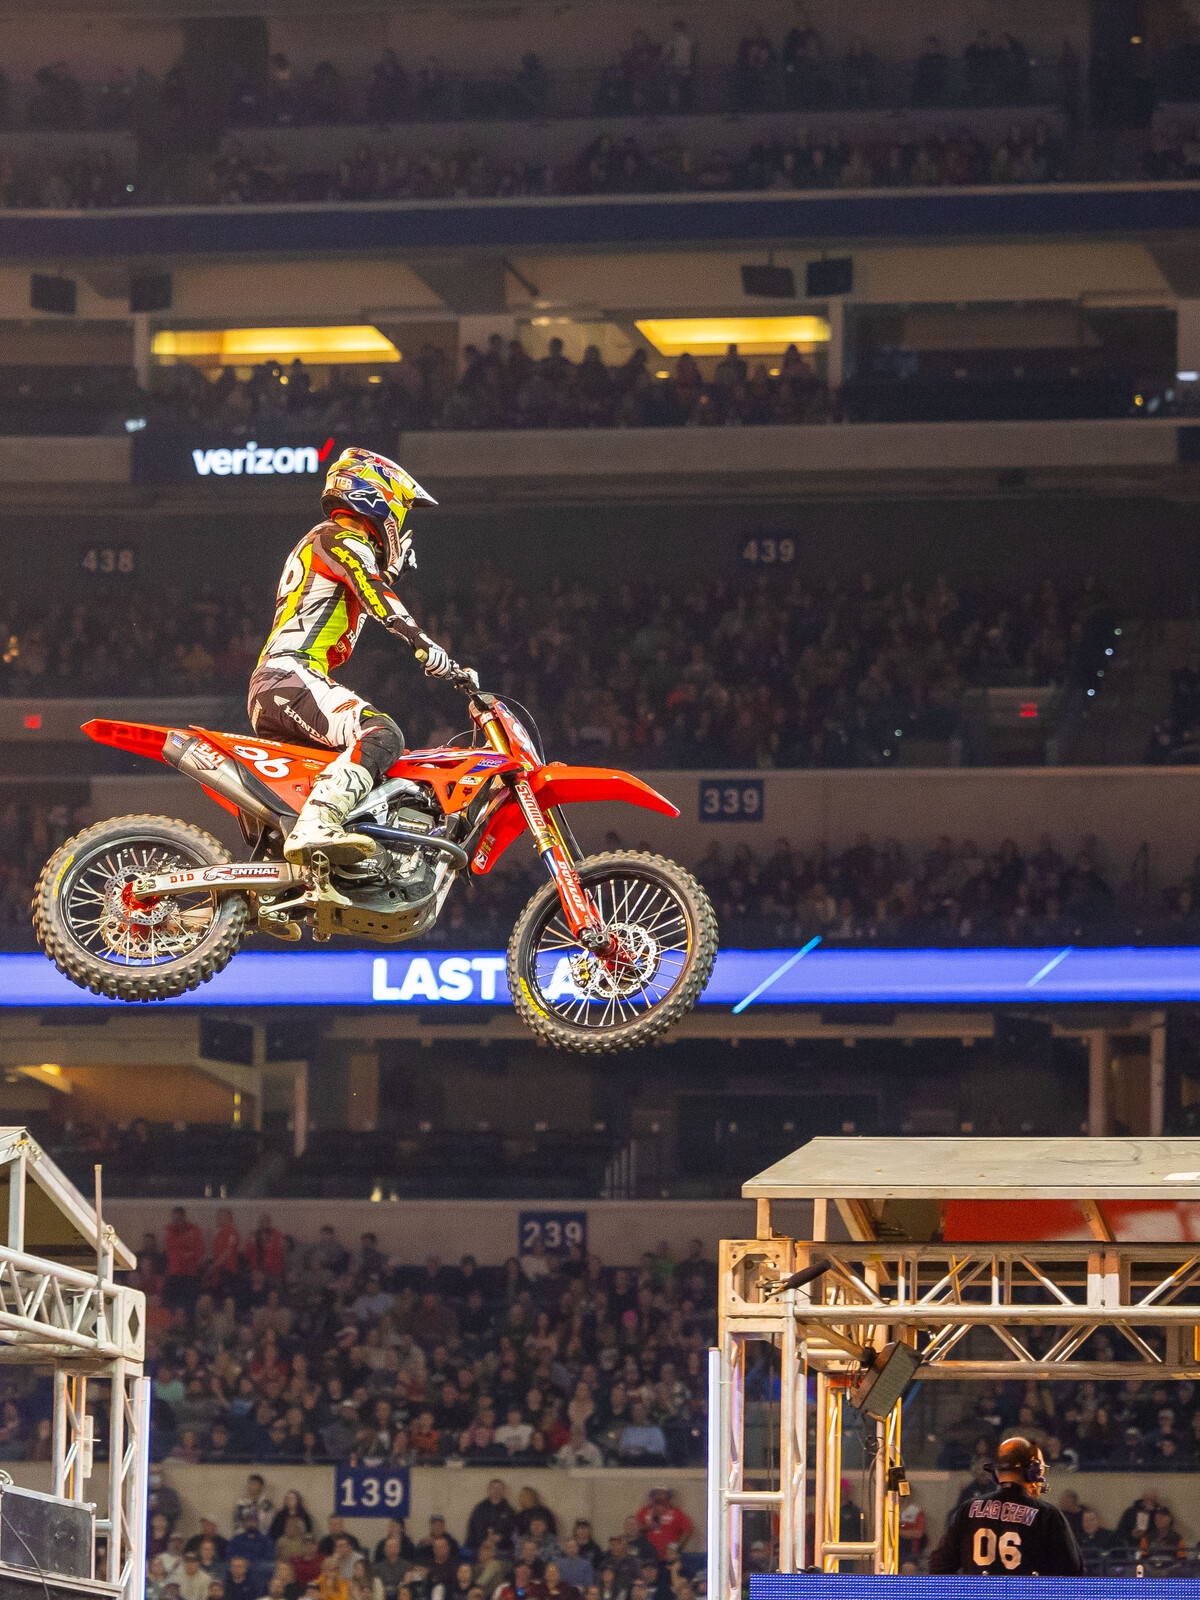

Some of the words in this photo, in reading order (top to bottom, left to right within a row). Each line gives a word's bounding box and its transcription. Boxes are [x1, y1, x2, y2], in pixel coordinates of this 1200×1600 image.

[192, 442, 319, 476] verizon
[83, 549, 133, 572] 438
[743, 539, 794, 563] 439
[221, 733, 283, 748] HONDA
[284, 705, 334, 748] HONDA
[233, 745, 298, 778] 96
[704, 788, 760, 814] 339
[170, 873, 194, 884] DID
[558, 860, 586, 912] DUNLOP
[372, 957, 507, 1001] LAST
[523, 1221, 583, 1248] 239
[340, 1478, 404, 1508] 139
[968, 1500, 1001, 1520] FLAG
[1000, 1502, 1039, 1526] CREW
[972, 1527, 1023, 1570] 06
